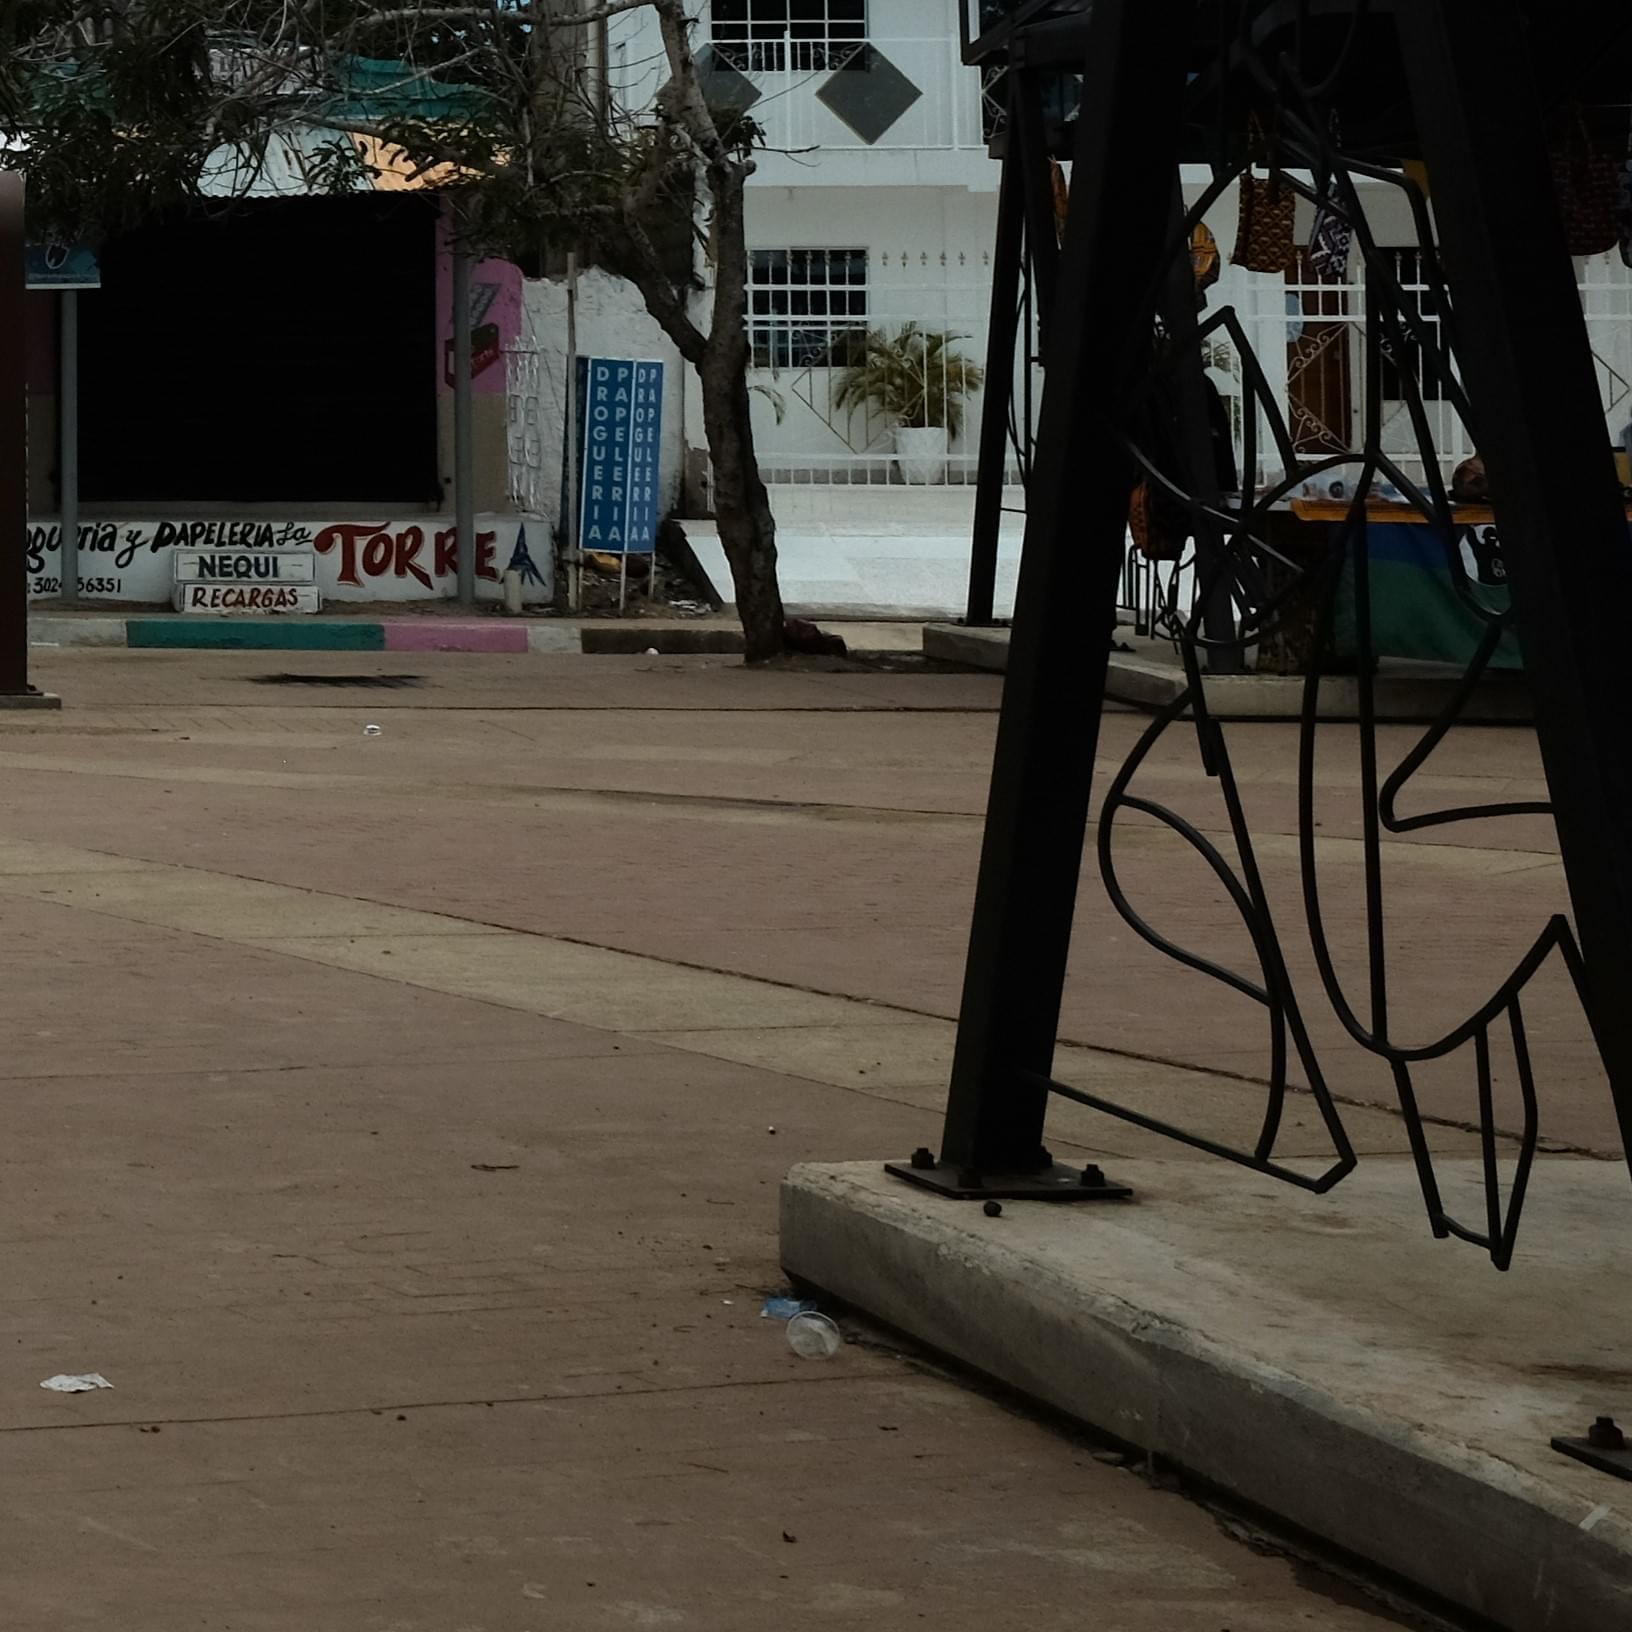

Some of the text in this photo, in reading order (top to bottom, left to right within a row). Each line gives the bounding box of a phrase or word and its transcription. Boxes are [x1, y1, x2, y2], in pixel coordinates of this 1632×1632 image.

[588, 366, 610, 541] DROGUERIA
[608, 367, 629, 542] PAPELERIA
[629, 368, 646, 541] DROGUERIA
[641, 369, 657, 541] PAPELERIA
[33, 576, 121, 594] 30256351
[115, 530, 150, 568] y
[151, 522, 274, 552] PAPELERIA
[314, 521, 498, 590] TORRE
[192, 587, 298, 608] RECARGAS
[198, 555, 278, 578] NEQUI
